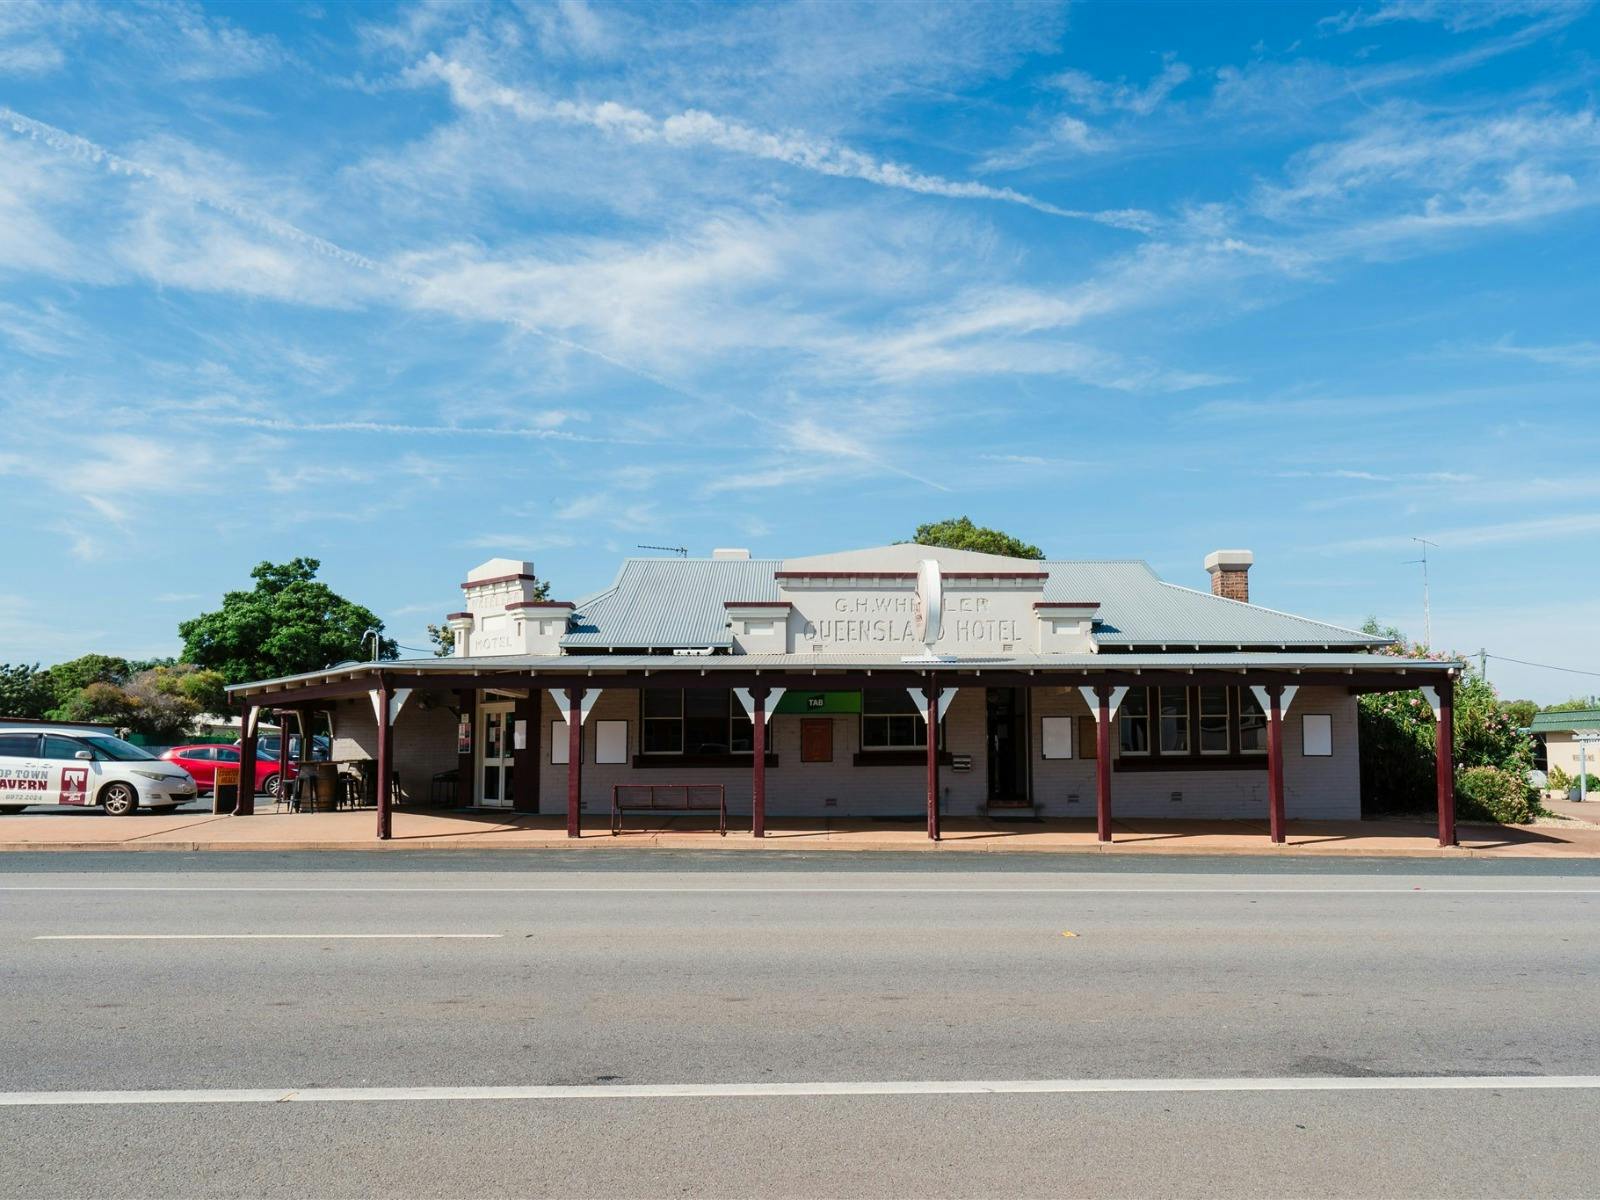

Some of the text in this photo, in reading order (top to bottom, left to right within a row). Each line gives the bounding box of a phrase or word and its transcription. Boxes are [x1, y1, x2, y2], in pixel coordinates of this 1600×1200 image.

[835, 598, 988, 612] G.H.WHLER
[804, 620, 1022, 641] QUEENSLA HOTEL
[16, 770, 48, 779] TOWN
